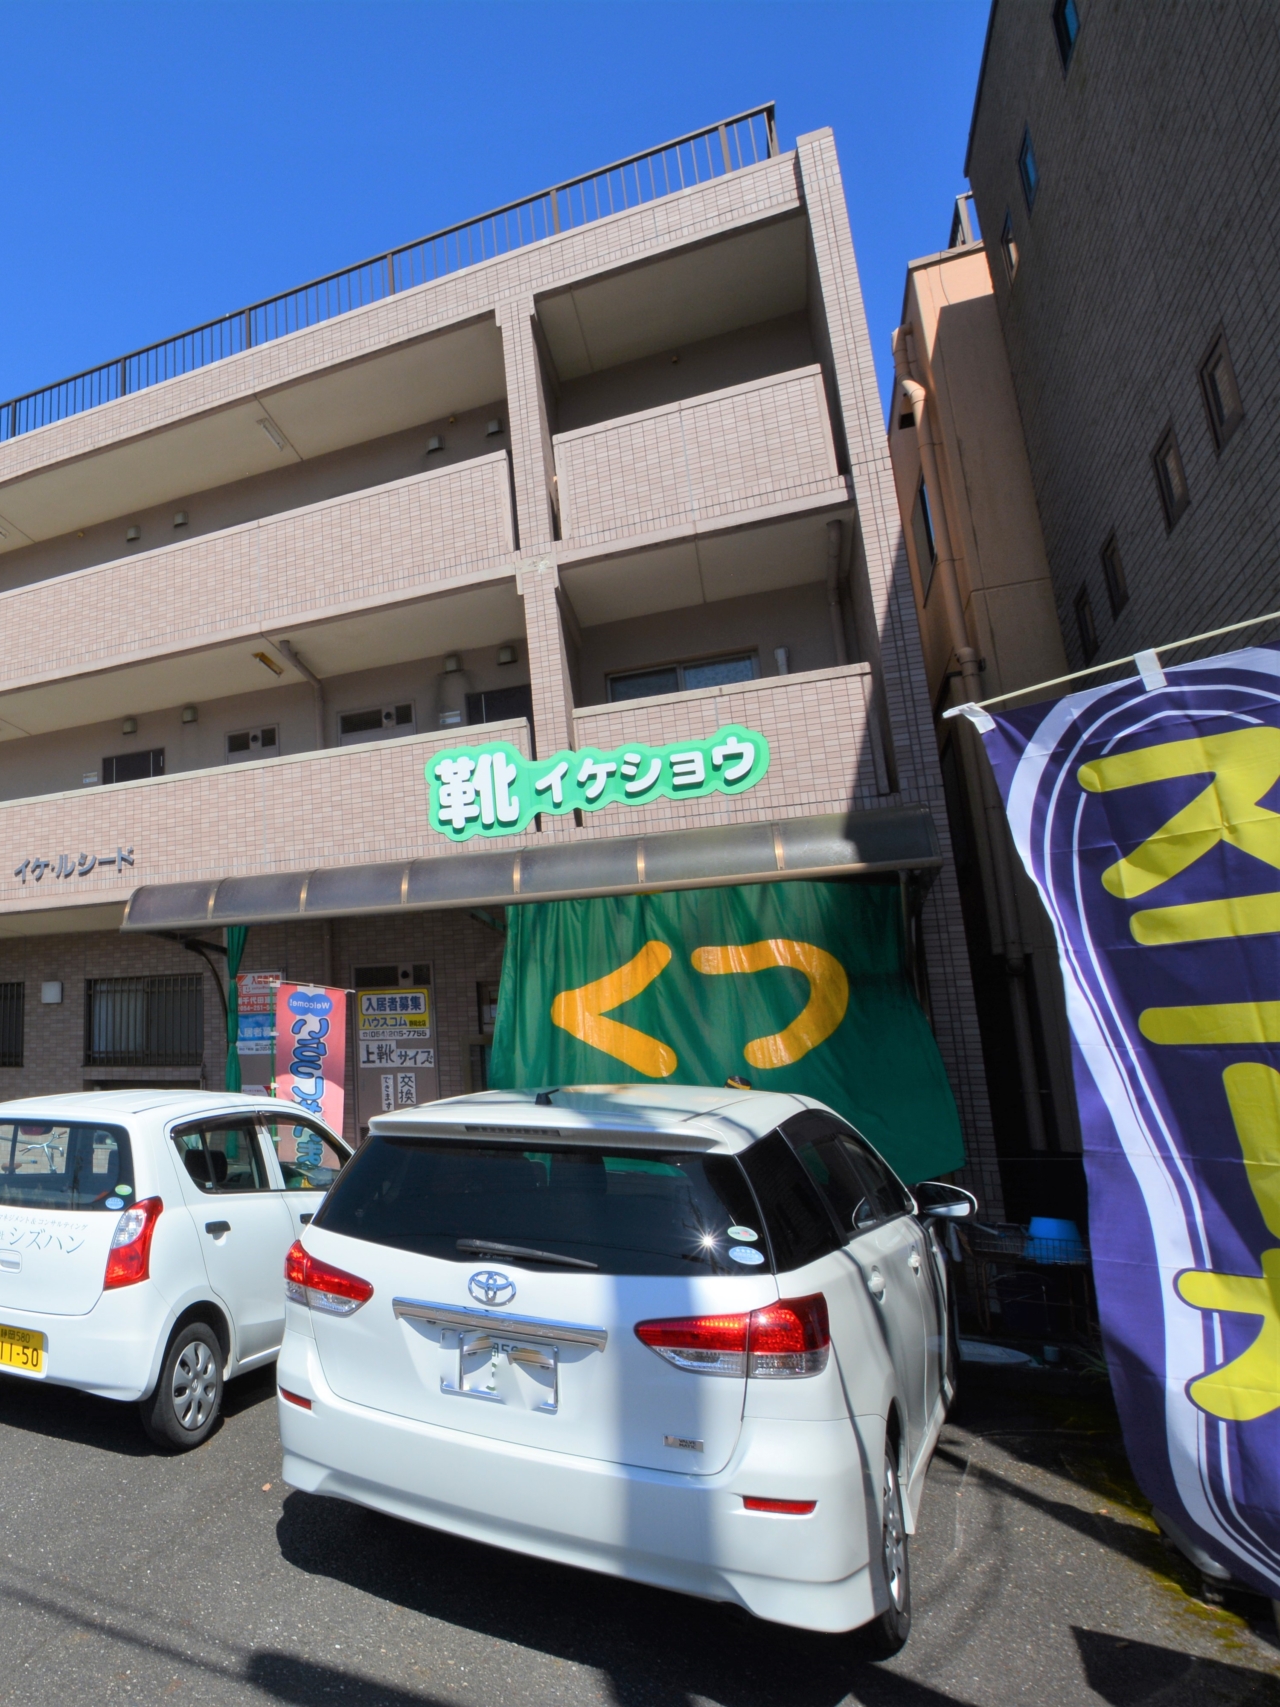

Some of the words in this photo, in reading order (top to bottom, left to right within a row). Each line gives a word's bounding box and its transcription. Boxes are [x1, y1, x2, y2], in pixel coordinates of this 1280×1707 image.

[434, 751, 520, 829] 靴
[534, 736, 756, 804] イケショウ
[365, 995, 421, 1012] 入居者募集
[550, 939, 849, 1078] くつ
[362, 1016, 407, 1028] ハウスコム
[362, 1044, 396, 1064] 上靴
[397, 1050, 433, 1066] サイズ
[382, 1076, 392, 1110] できます
[399, 1074, 415, 1103] 交換
[10, 1227, 85, 1254] シズハン
[0, 1341, 39, 1367] 11-50
